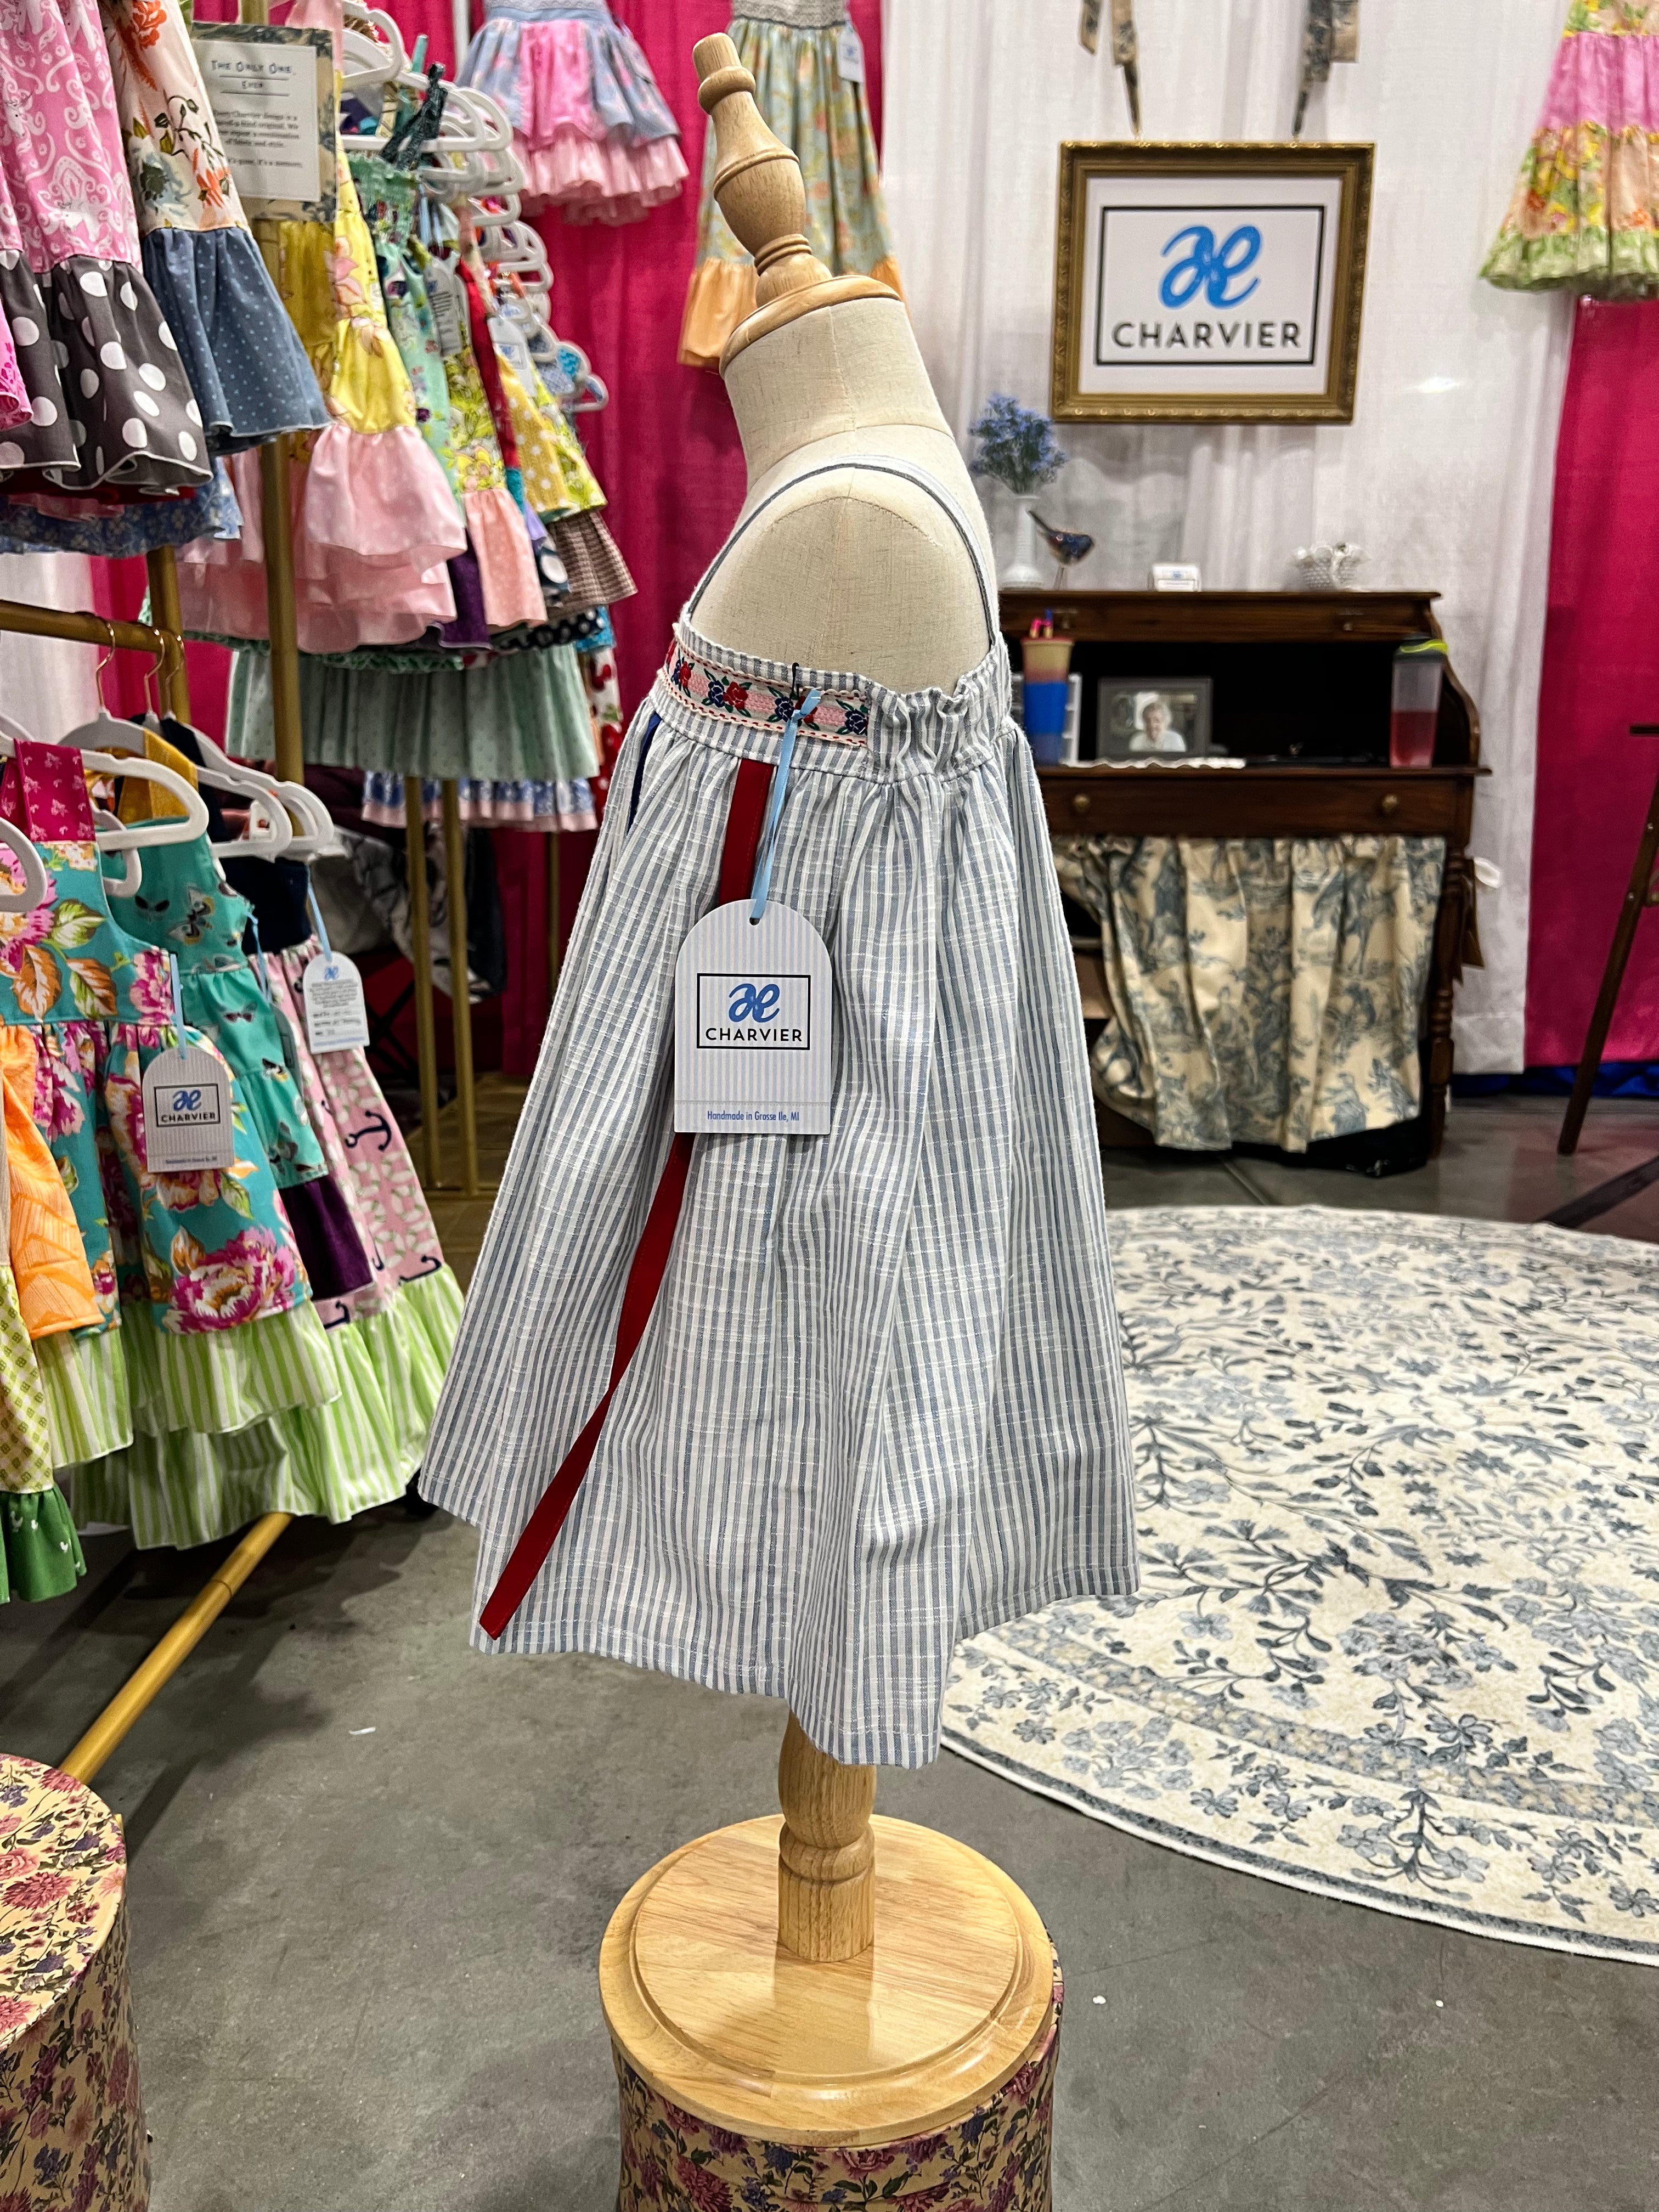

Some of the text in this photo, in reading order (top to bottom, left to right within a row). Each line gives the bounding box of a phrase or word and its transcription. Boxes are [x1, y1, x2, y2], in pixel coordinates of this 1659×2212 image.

[1113, 323, 1300, 348] CHARVIER
[706, 1028, 803, 1042] CHARVIER
[161, 1112, 216, 1123] CHARVIER
[707, 1110, 744, 1121] Handmade
[746, 1111, 753, 1121] in
[754, 1111, 777, 1121] Grosse
[791, 1111, 800, 1121] MI
